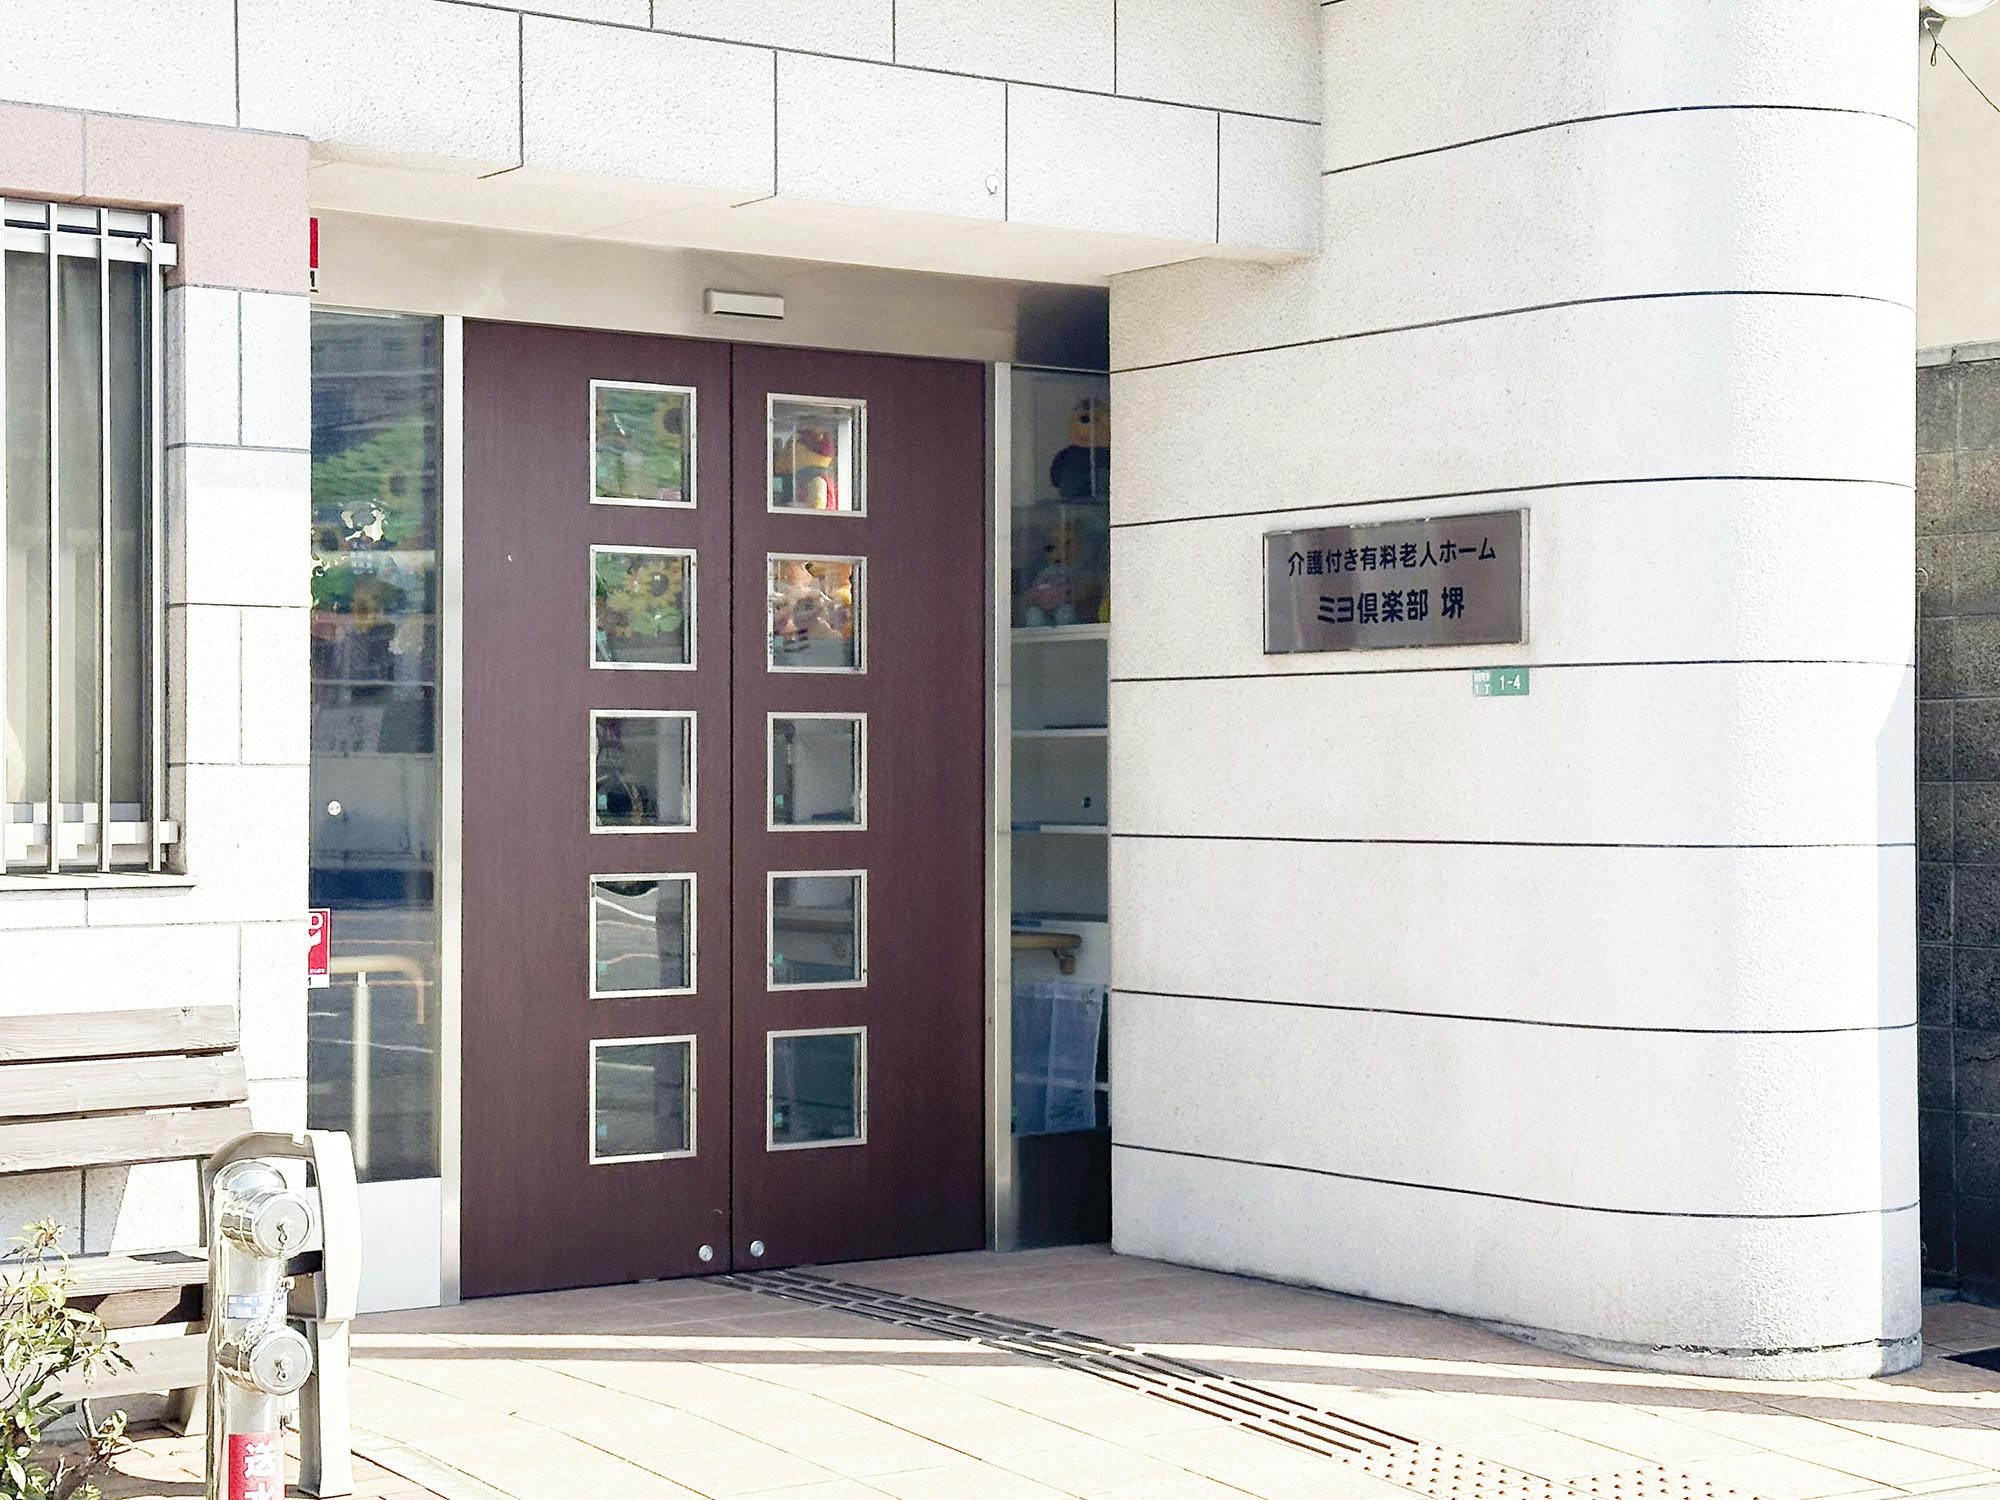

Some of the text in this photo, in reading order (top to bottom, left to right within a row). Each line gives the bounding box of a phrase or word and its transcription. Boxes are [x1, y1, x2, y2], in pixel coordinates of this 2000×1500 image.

[1288, 537, 1496, 576] 介護付き有料老人ホーム
[1317, 586, 1465, 624] ミヨ倶楽部 堺
[1499, 674, 1522, 691] 1-4
